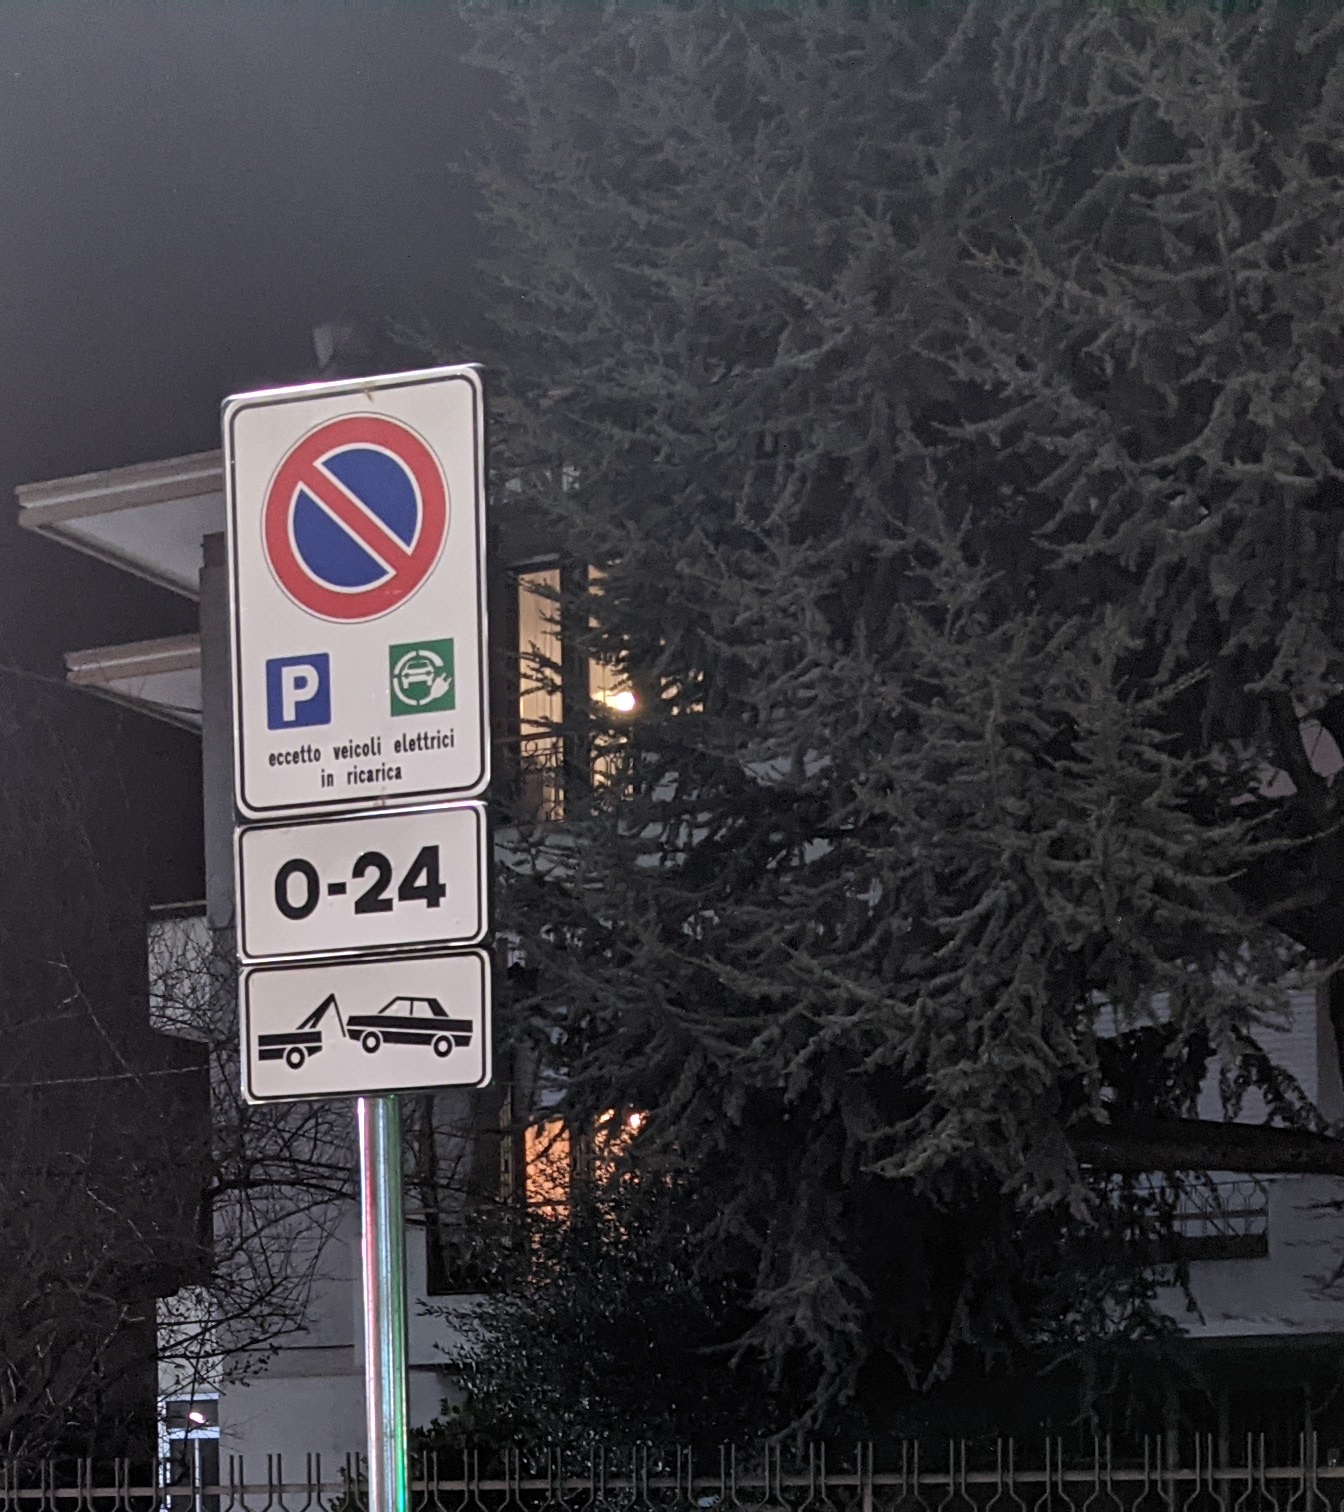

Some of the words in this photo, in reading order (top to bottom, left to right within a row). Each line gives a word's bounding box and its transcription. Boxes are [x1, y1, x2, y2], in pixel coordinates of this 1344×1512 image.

[281, 664, 319, 721] P
[269, 744, 321, 766] eccetto
[333, 736, 381, 760] veicoli
[394, 728, 455, 753] elettrici
[321, 769, 334, 788] in
[347, 762, 402, 785] ricarica
[274, 845, 446, 921] 0-24
